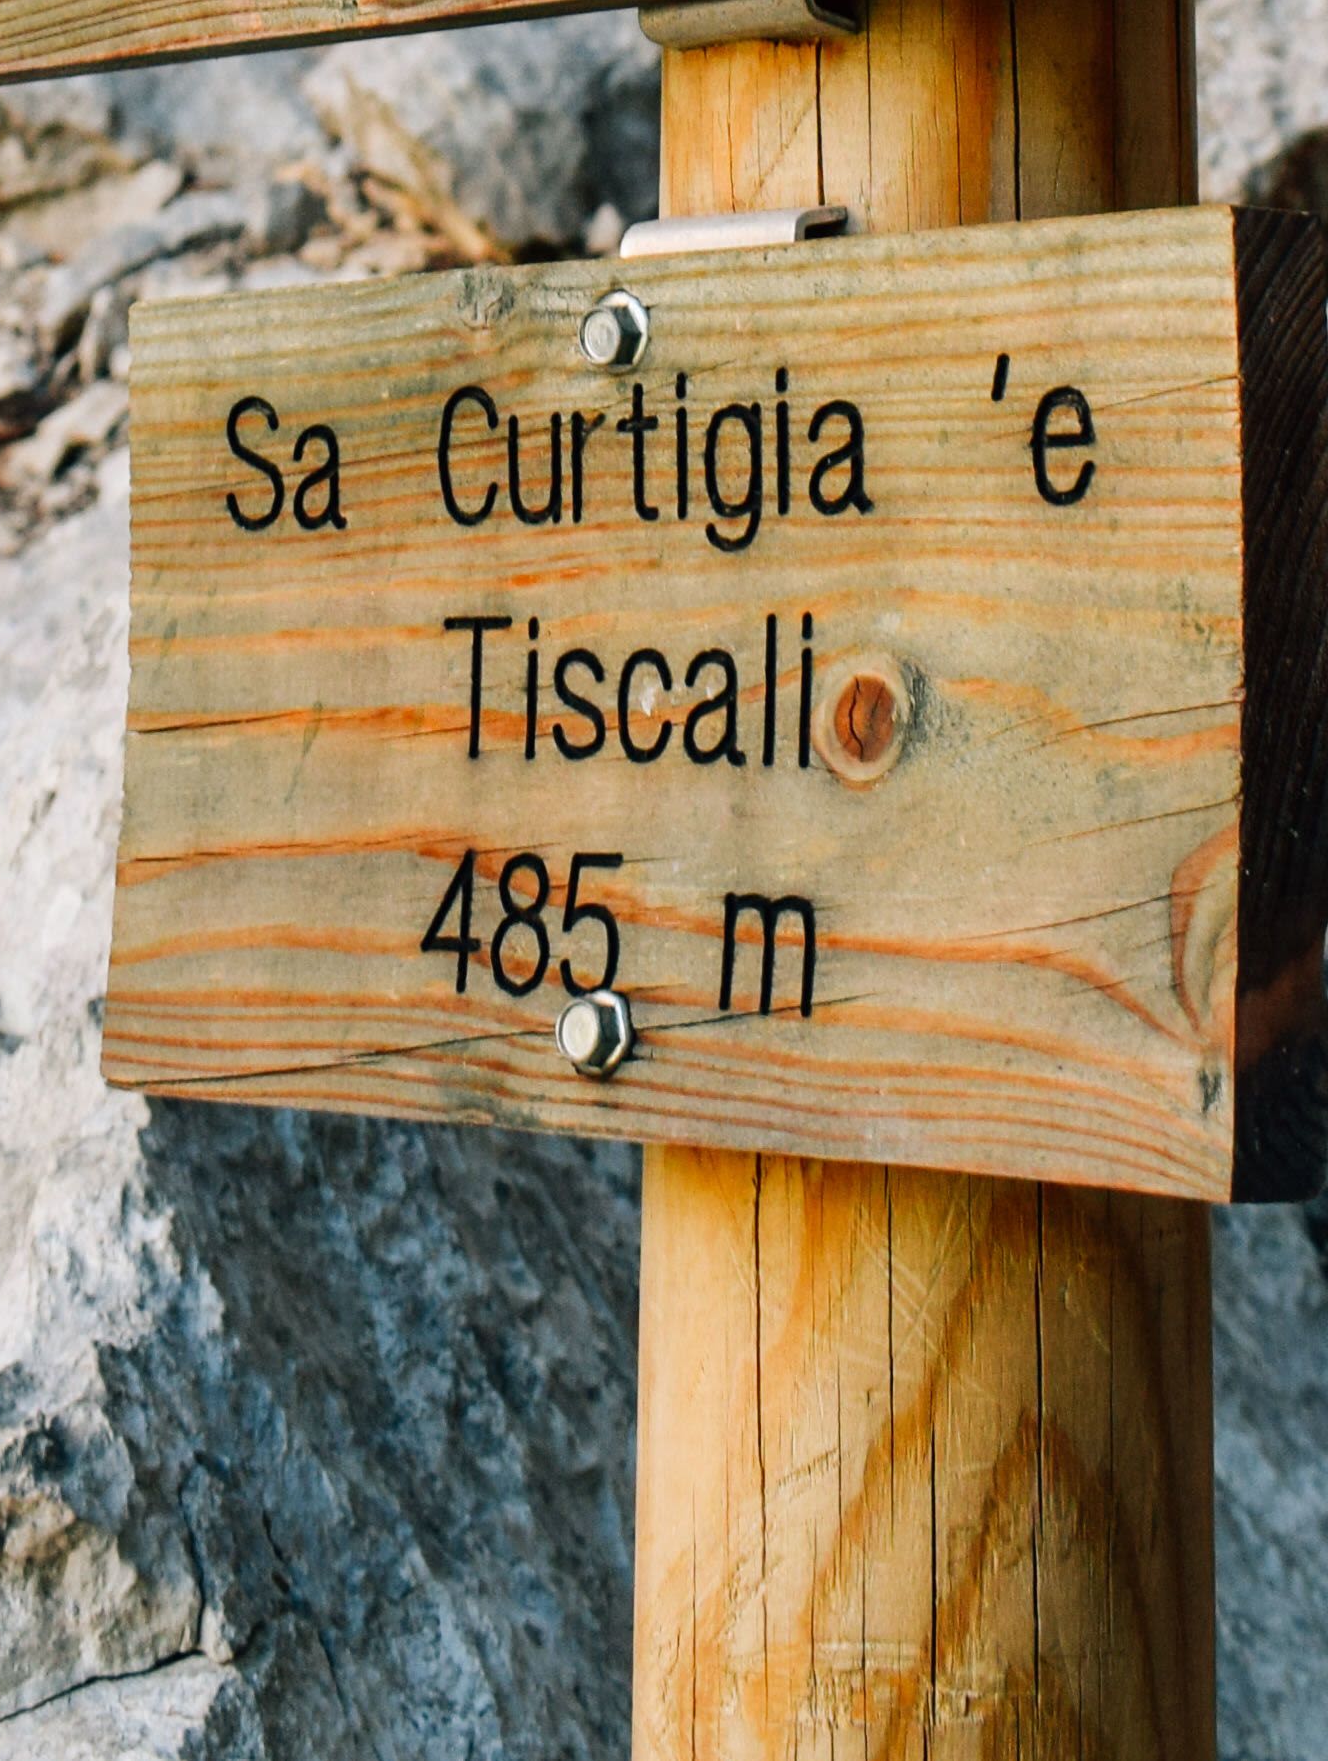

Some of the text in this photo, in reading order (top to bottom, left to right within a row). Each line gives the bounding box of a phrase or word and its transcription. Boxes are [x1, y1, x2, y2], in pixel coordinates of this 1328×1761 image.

[224, 353, 1097, 552] Sa Curtigia 'e
[443, 612, 813, 768] Tiscali
[419, 848, 816, 1017] 485 m
